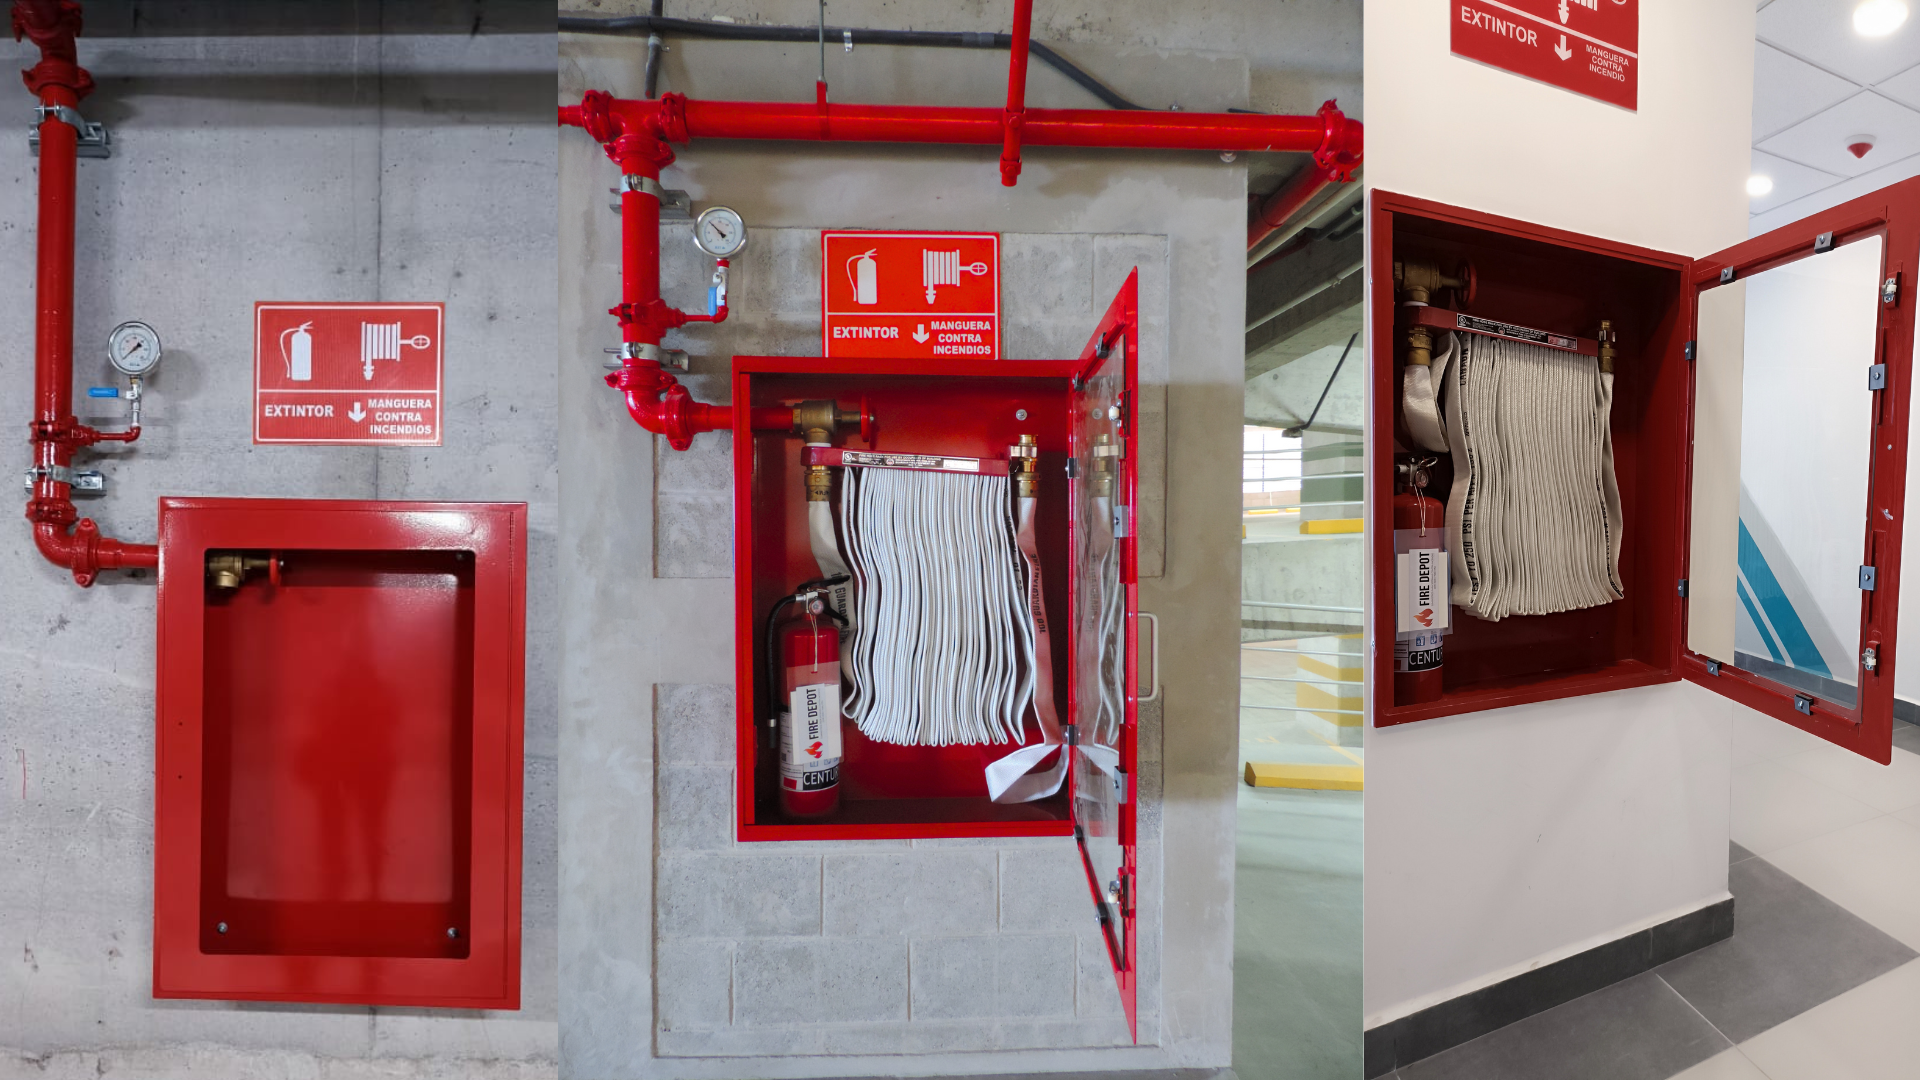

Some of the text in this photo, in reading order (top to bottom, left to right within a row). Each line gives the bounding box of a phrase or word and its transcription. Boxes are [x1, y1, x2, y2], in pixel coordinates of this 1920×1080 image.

[1461, 5, 1538, 48] EXTINTOR
[1586, 44, 1629, 67] MANGUERA
[1591, 55, 1624, 73] CONTRA
[1589, 63, 1626, 82] INCENDIO
[931, 320, 991, 330] MANGUERA
[833, 326, 899, 339] EXTINTOR
[938, 333, 982, 343] CONTRA
[933, 345, 991, 355] INCENDIOS
[367, 398, 432, 409] MANGUERA
[264, 404, 334, 418] EXTINTOR
[375, 412, 422, 422] CONTRA
[369, 425, 432, 435] INCENDIOS
[1463, 541, 1474, 559] 250
[1419, 552, 1430, 606] FIRE DEPOT
[806, 688, 819, 740] FIRE DEPOT
